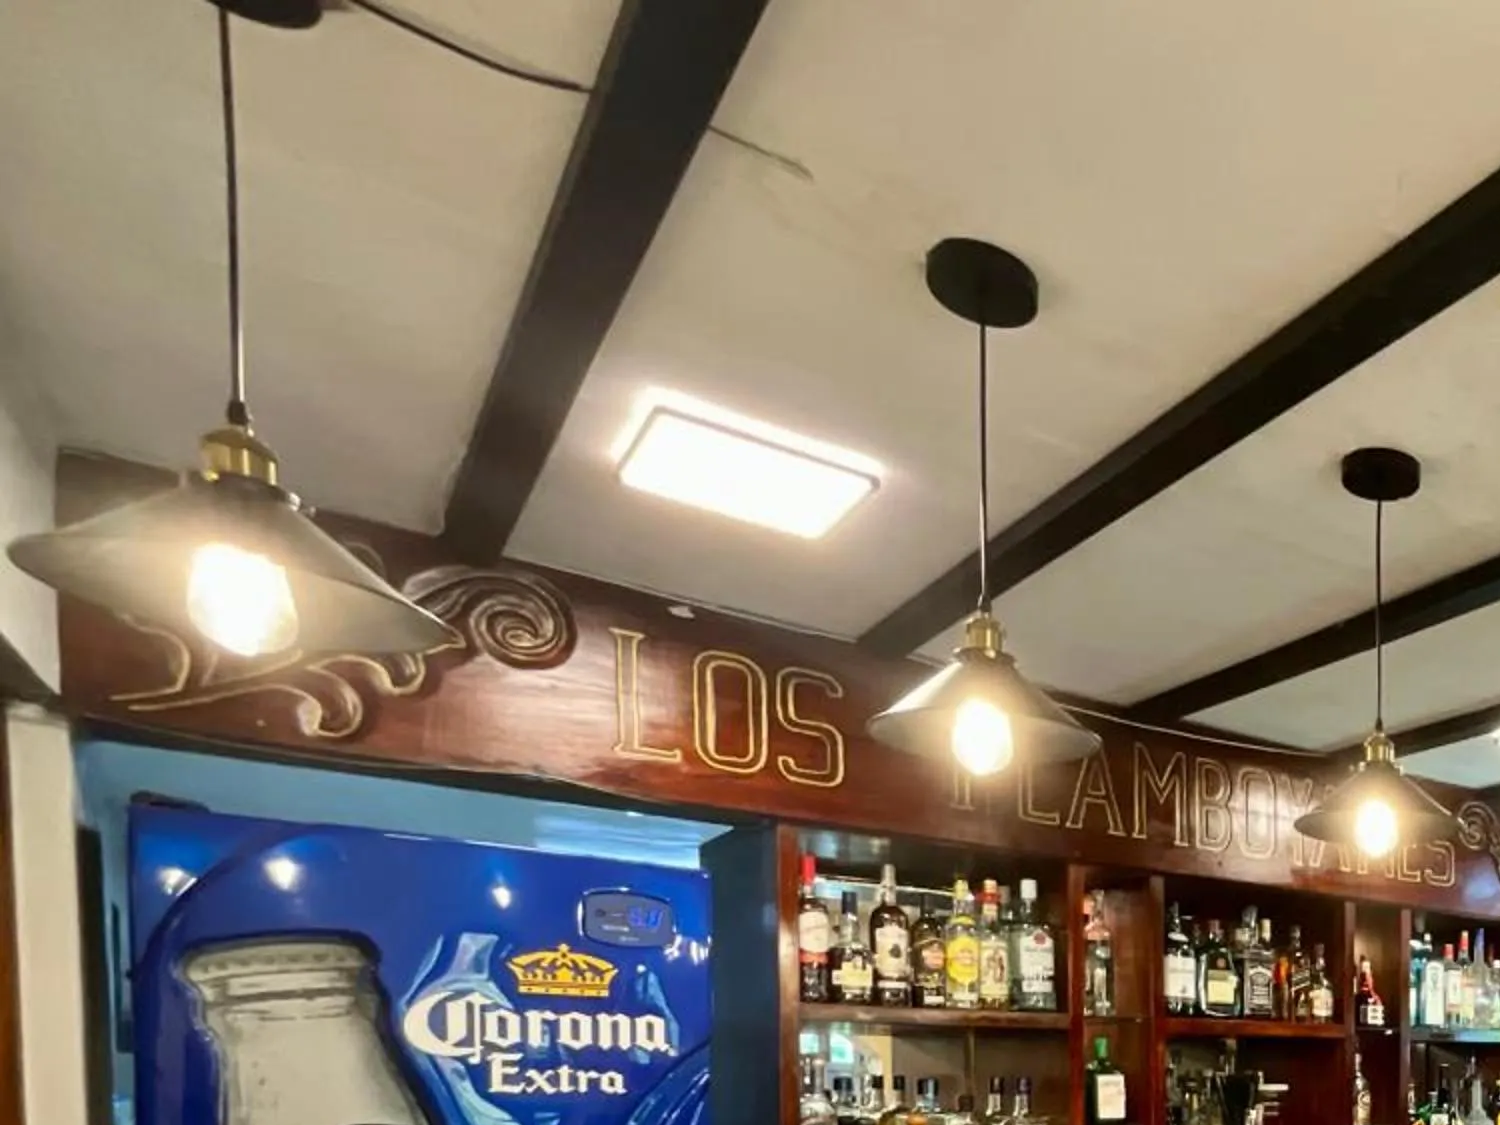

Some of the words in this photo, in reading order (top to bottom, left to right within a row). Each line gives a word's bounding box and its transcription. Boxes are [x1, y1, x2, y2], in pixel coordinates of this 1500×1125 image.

[608, 627, 845, 788] LOS
[403, 991, 680, 1064] Corona
[487, 1052, 628, 1095] Extra
